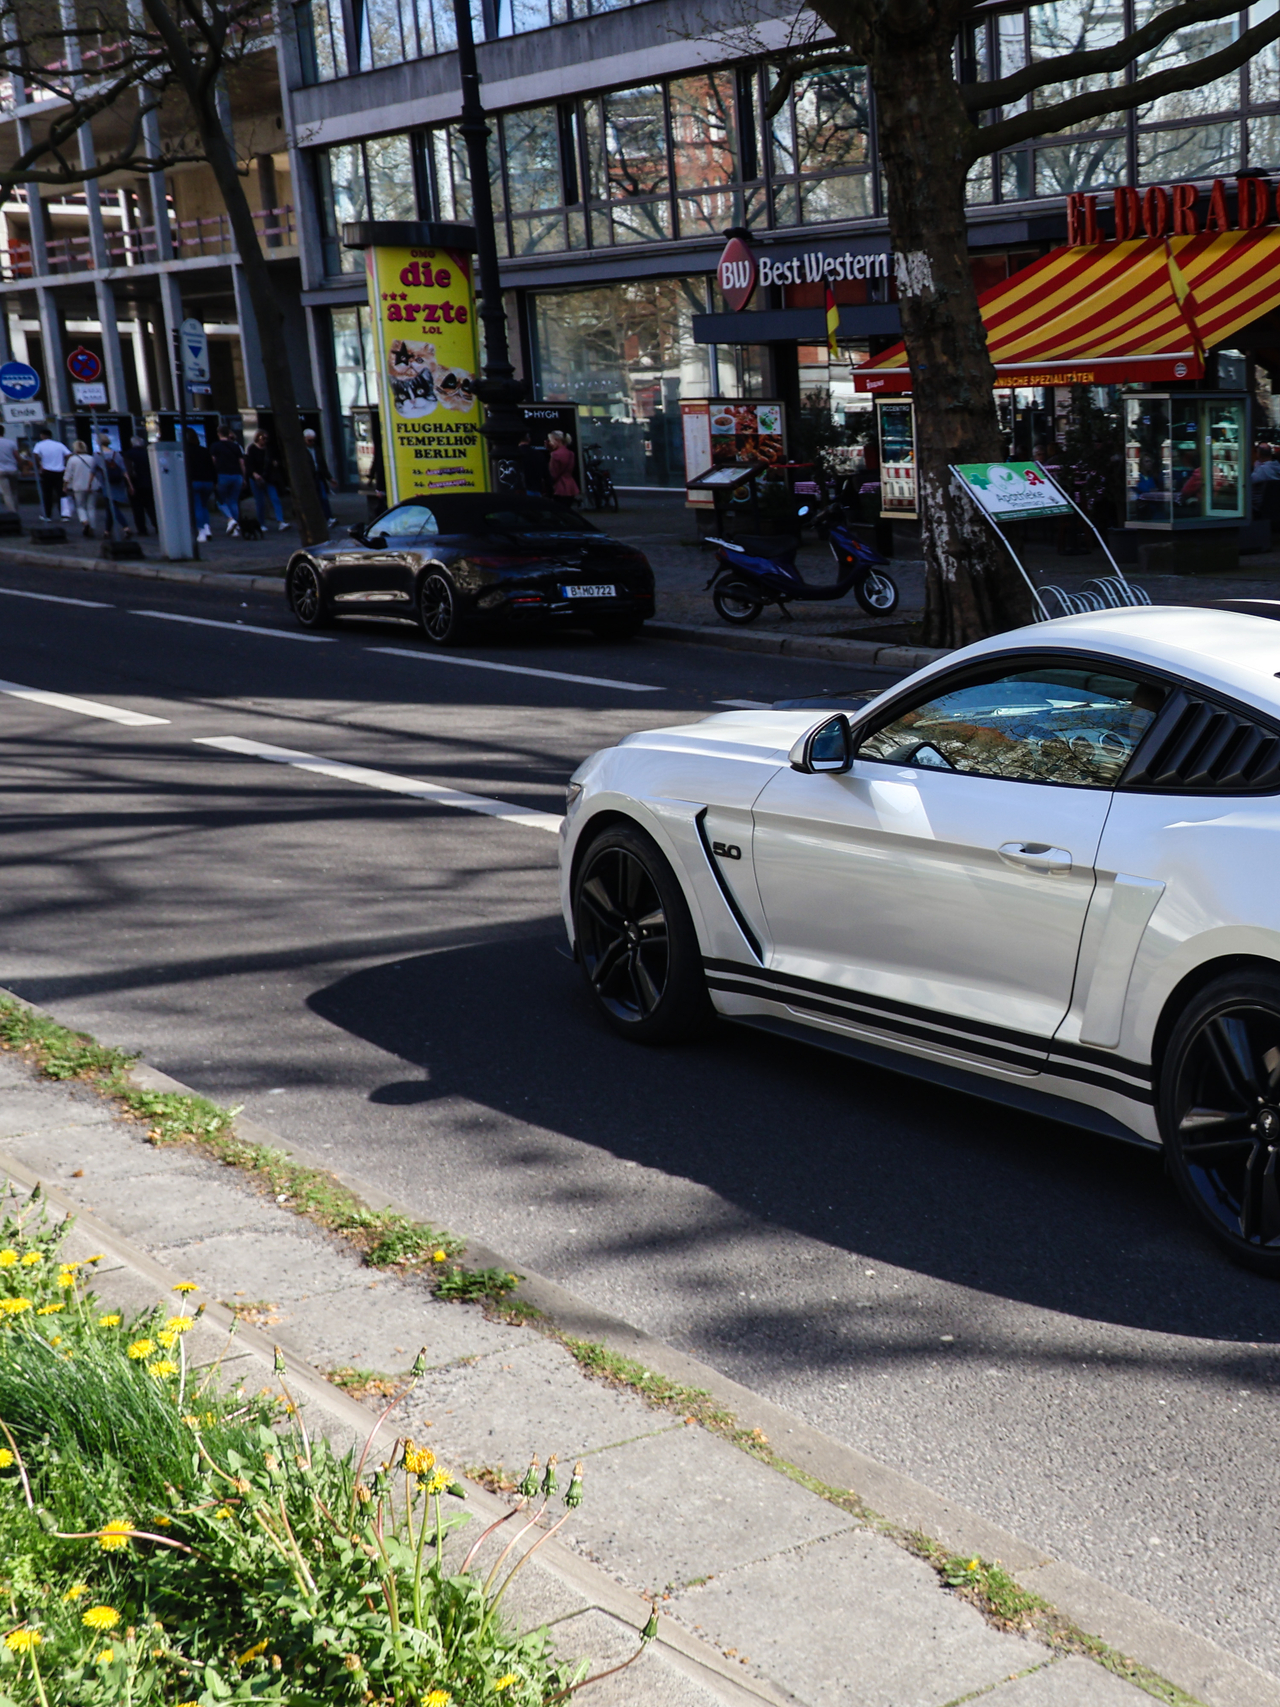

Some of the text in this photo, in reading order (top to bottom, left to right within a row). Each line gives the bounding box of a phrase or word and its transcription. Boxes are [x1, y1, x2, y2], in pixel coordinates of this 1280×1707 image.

[1067, 192, 1105, 246] EL
[410, 249, 436, 258] OMG
[399, 261, 452, 288] die
[722, 257, 751, 289] BW
[758, 253, 890, 287] Best Western
[421, 326, 443, 335] LOL
[993, 371, 1094, 387] ANISCHE SPEZIALITÄTEN
[10, 407, 38, 417] Ende
[533, 410, 560, 419] HYGH
[396, 422, 478, 434] FLUGHAFEN
[398, 435, 478, 447] TEMPELHOF
[414, 448, 467, 459] BERLIN
[995, 490, 1046, 503] Apotheke
[571, 586, 578, 596] B
[595, 585, 612, 596] 722
